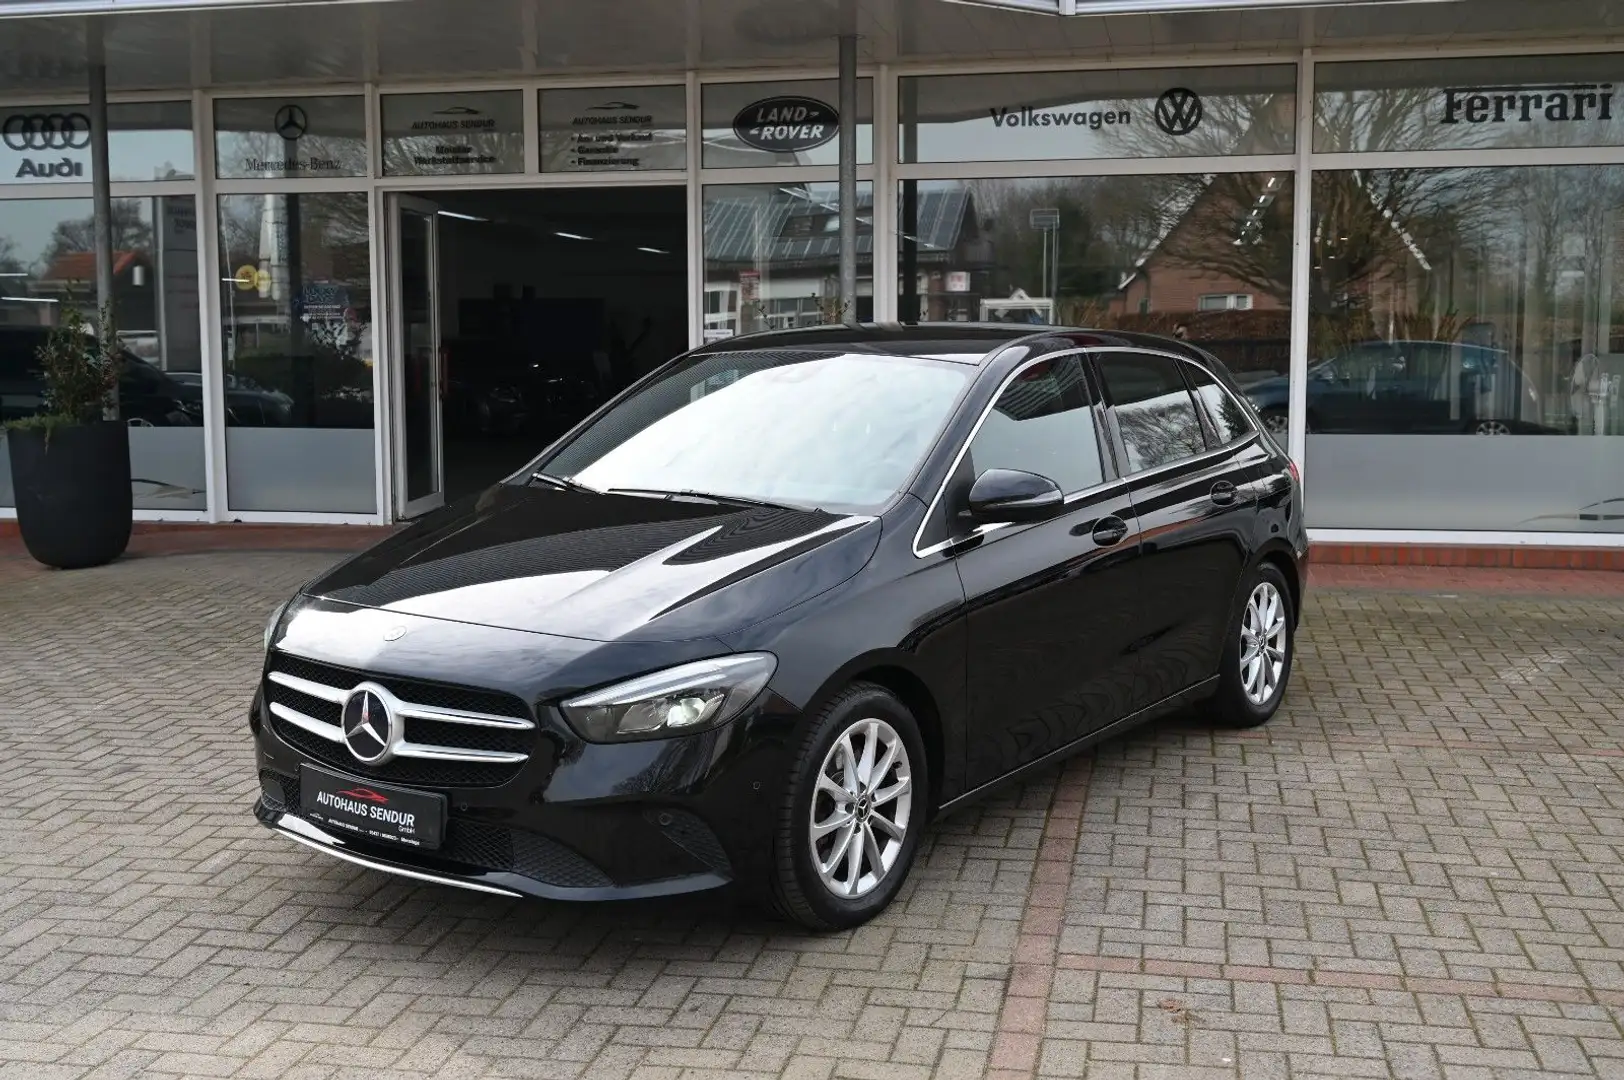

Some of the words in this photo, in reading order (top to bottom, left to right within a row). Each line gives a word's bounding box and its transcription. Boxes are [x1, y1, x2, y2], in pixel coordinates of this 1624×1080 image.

[1440, 82, 1613, 124] Ferrari
[571, 116, 618, 125] AUTOHAUS
[619, 114, 652, 124] SENDUR
[756, 107, 807, 123] LAND
[990, 107, 1131, 130] Volkswagen
[411, 120, 459, 130] AUTOHAUS
[460, 118, 495, 129] SENDUR
[760, 124, 824, 140] ROVER
[15, 157, 83, 178] Audi
[245, 157, 342, 170] Mercedes-Benz
[578, 157, 639, 167] Finanzierung
[317, 791, 368, 816] AUTOHAUS
[369, 806, 415, 828] SENDUR
[398, 825, 416, 834] GmbH
